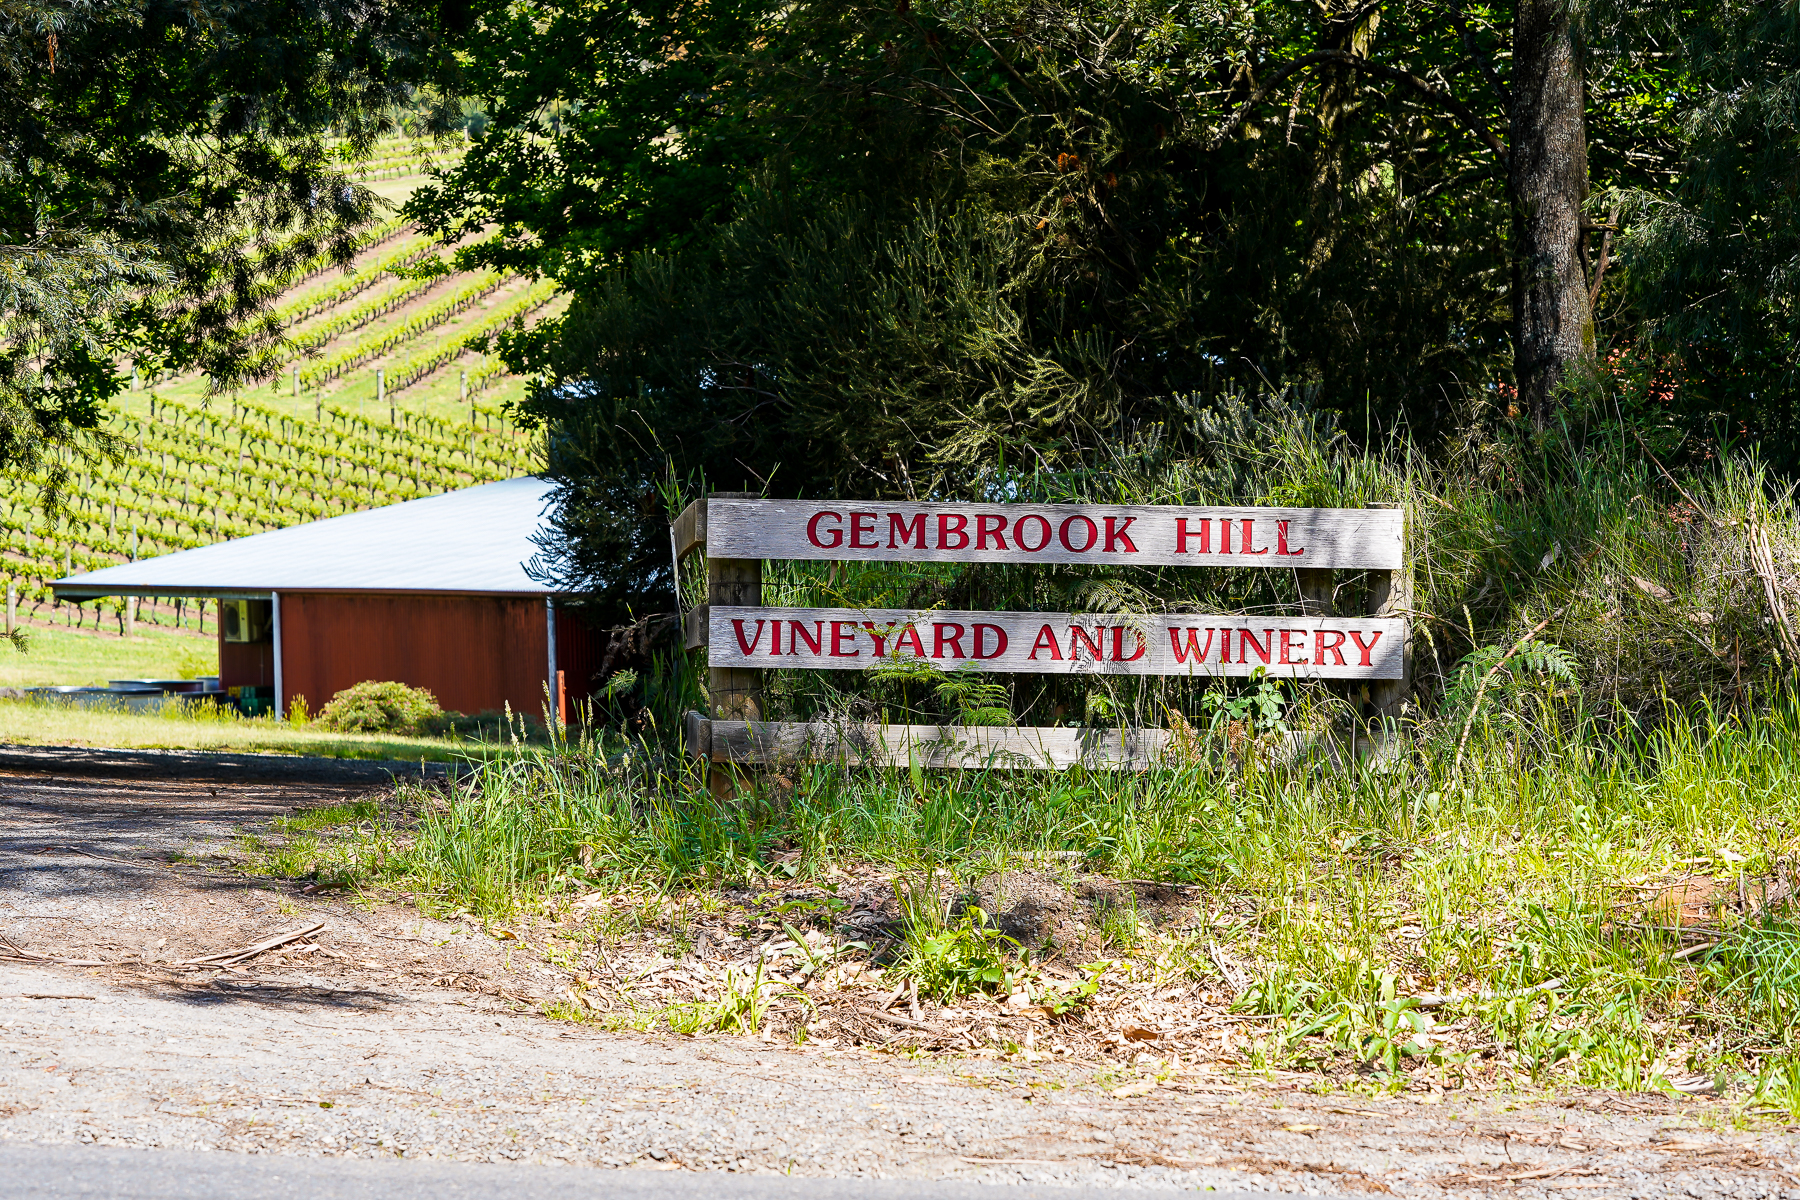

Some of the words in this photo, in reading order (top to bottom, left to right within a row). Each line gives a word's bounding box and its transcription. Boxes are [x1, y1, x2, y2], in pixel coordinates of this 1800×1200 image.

[806, 511, 1138, 553] GEMBROOK
[1175, 517, 1304, 556] HILL
[731, 619, 1007, 660] VINEYARD
[1027, 624, 1146, 663] AND
[1168, 627, 1383, 668] WINERY
